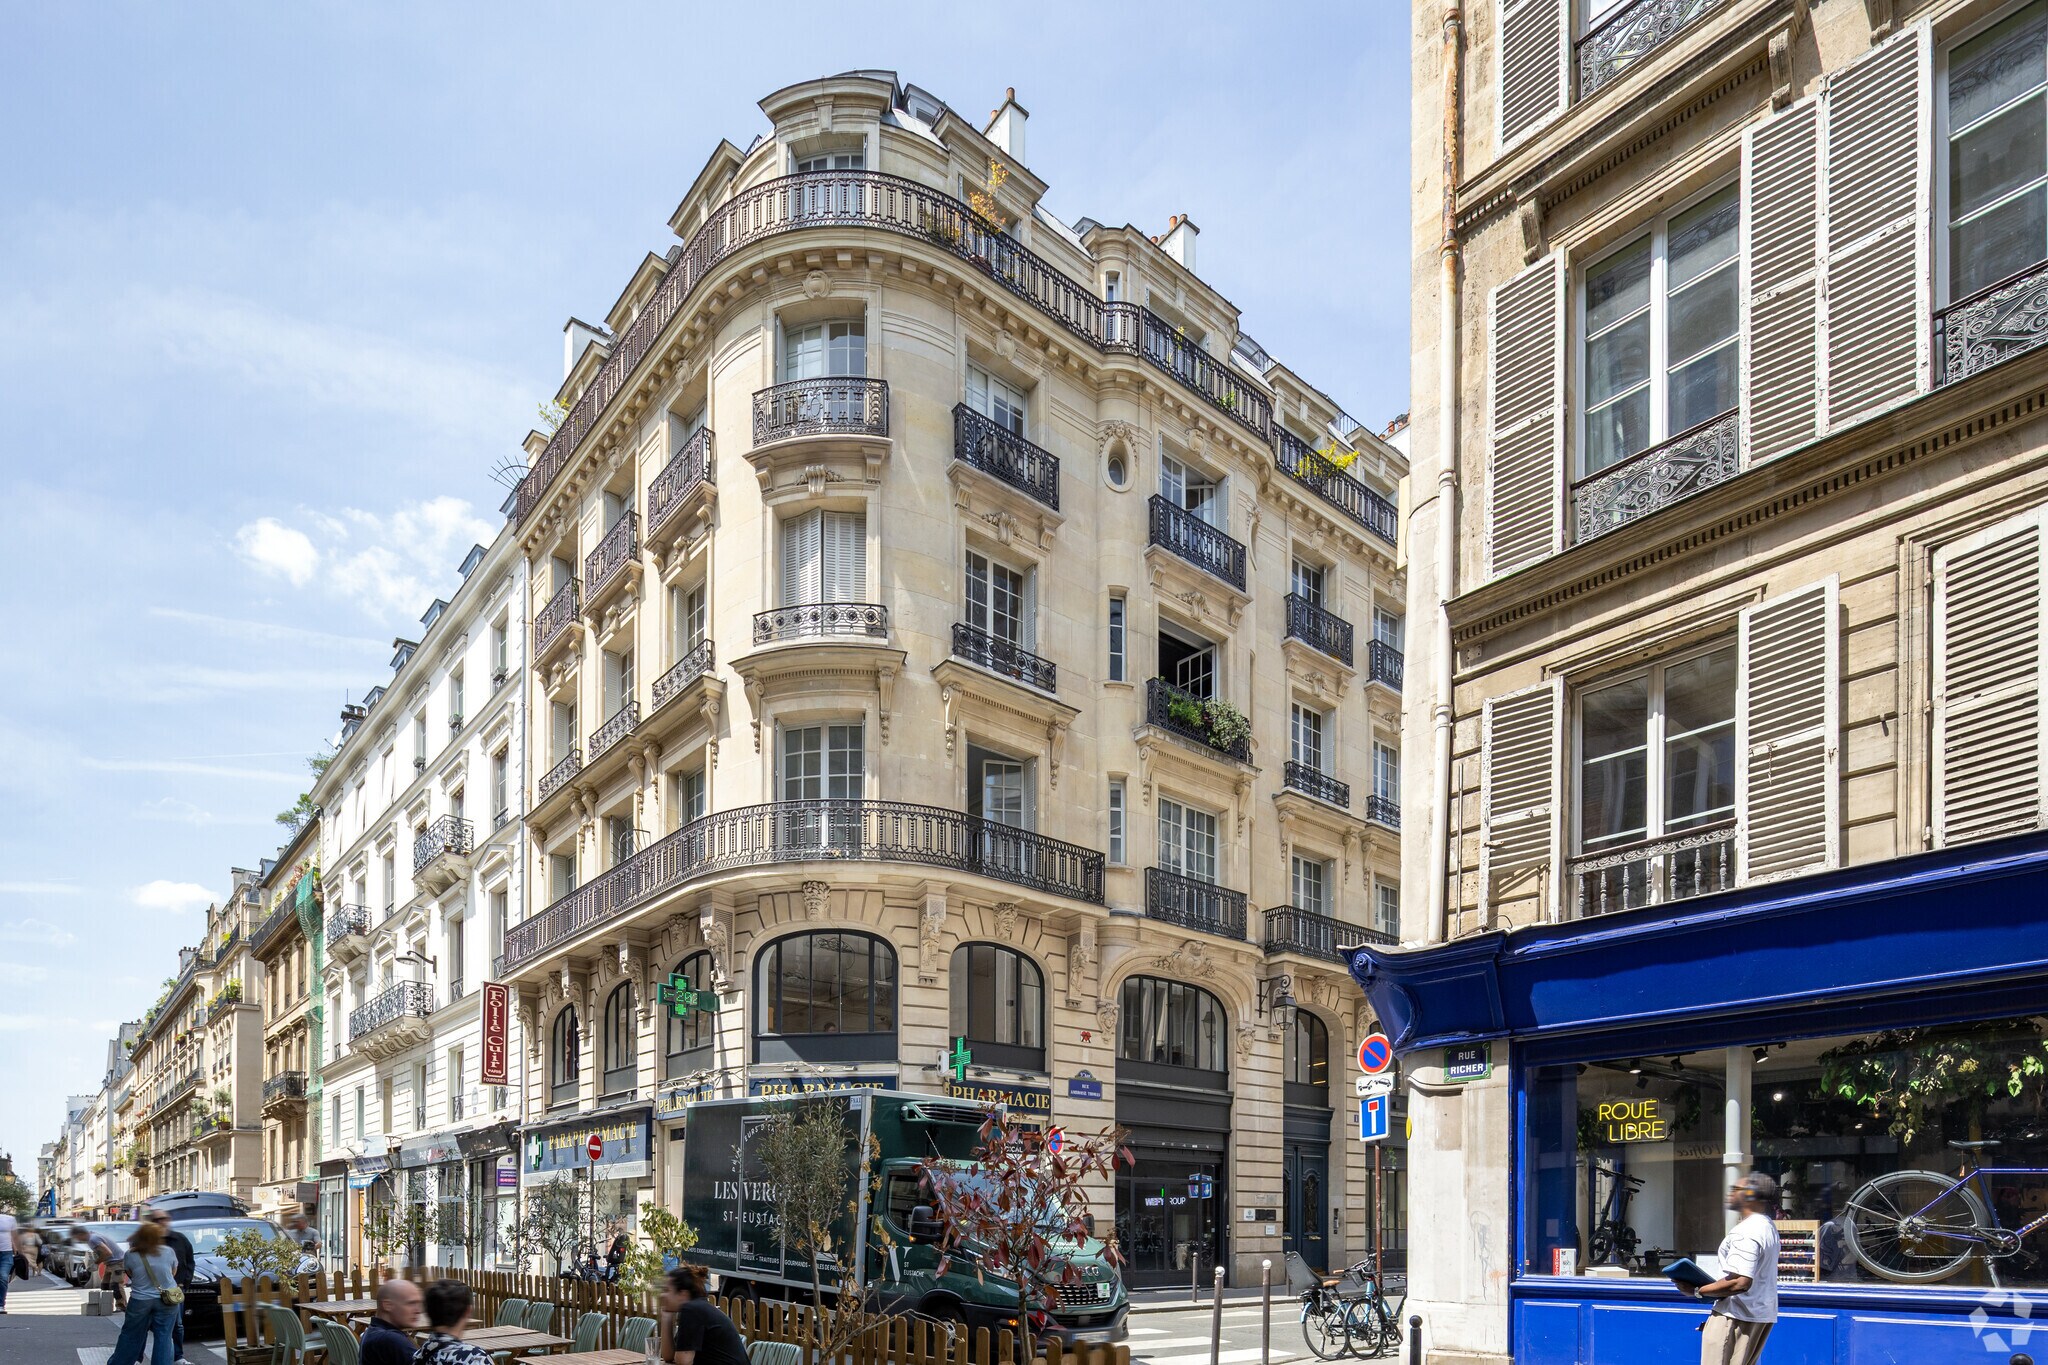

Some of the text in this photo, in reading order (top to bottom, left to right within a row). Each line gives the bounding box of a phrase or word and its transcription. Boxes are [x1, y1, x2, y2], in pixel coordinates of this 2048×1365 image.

[487, 989, 504, 1068] Folie Cuir
[1458, 1050, 1476, 1060] RUE
[1450, 1063, 1484, 1075] RICHER
[658, 1090, 713, 1113] PHARMACIE
[952, 1085, 1050, 1109] PHARMACIE
[1599, 1099, 1658, 1121] ROUE
[549, 1121, 637, 1151] PARAPHRMACIE
[1609, 1120, 1666, 1141] LIBRE
[714, 1181, 738, 1200] LES
[1169, 1197, 1186, 1205] ROUP
[723, 1211, 781, 1226] ST-EUSTAC
[758, 1256, 780, 1264] TRAITEURS
[785, 1259, 808, 1267] GOURMANDS
